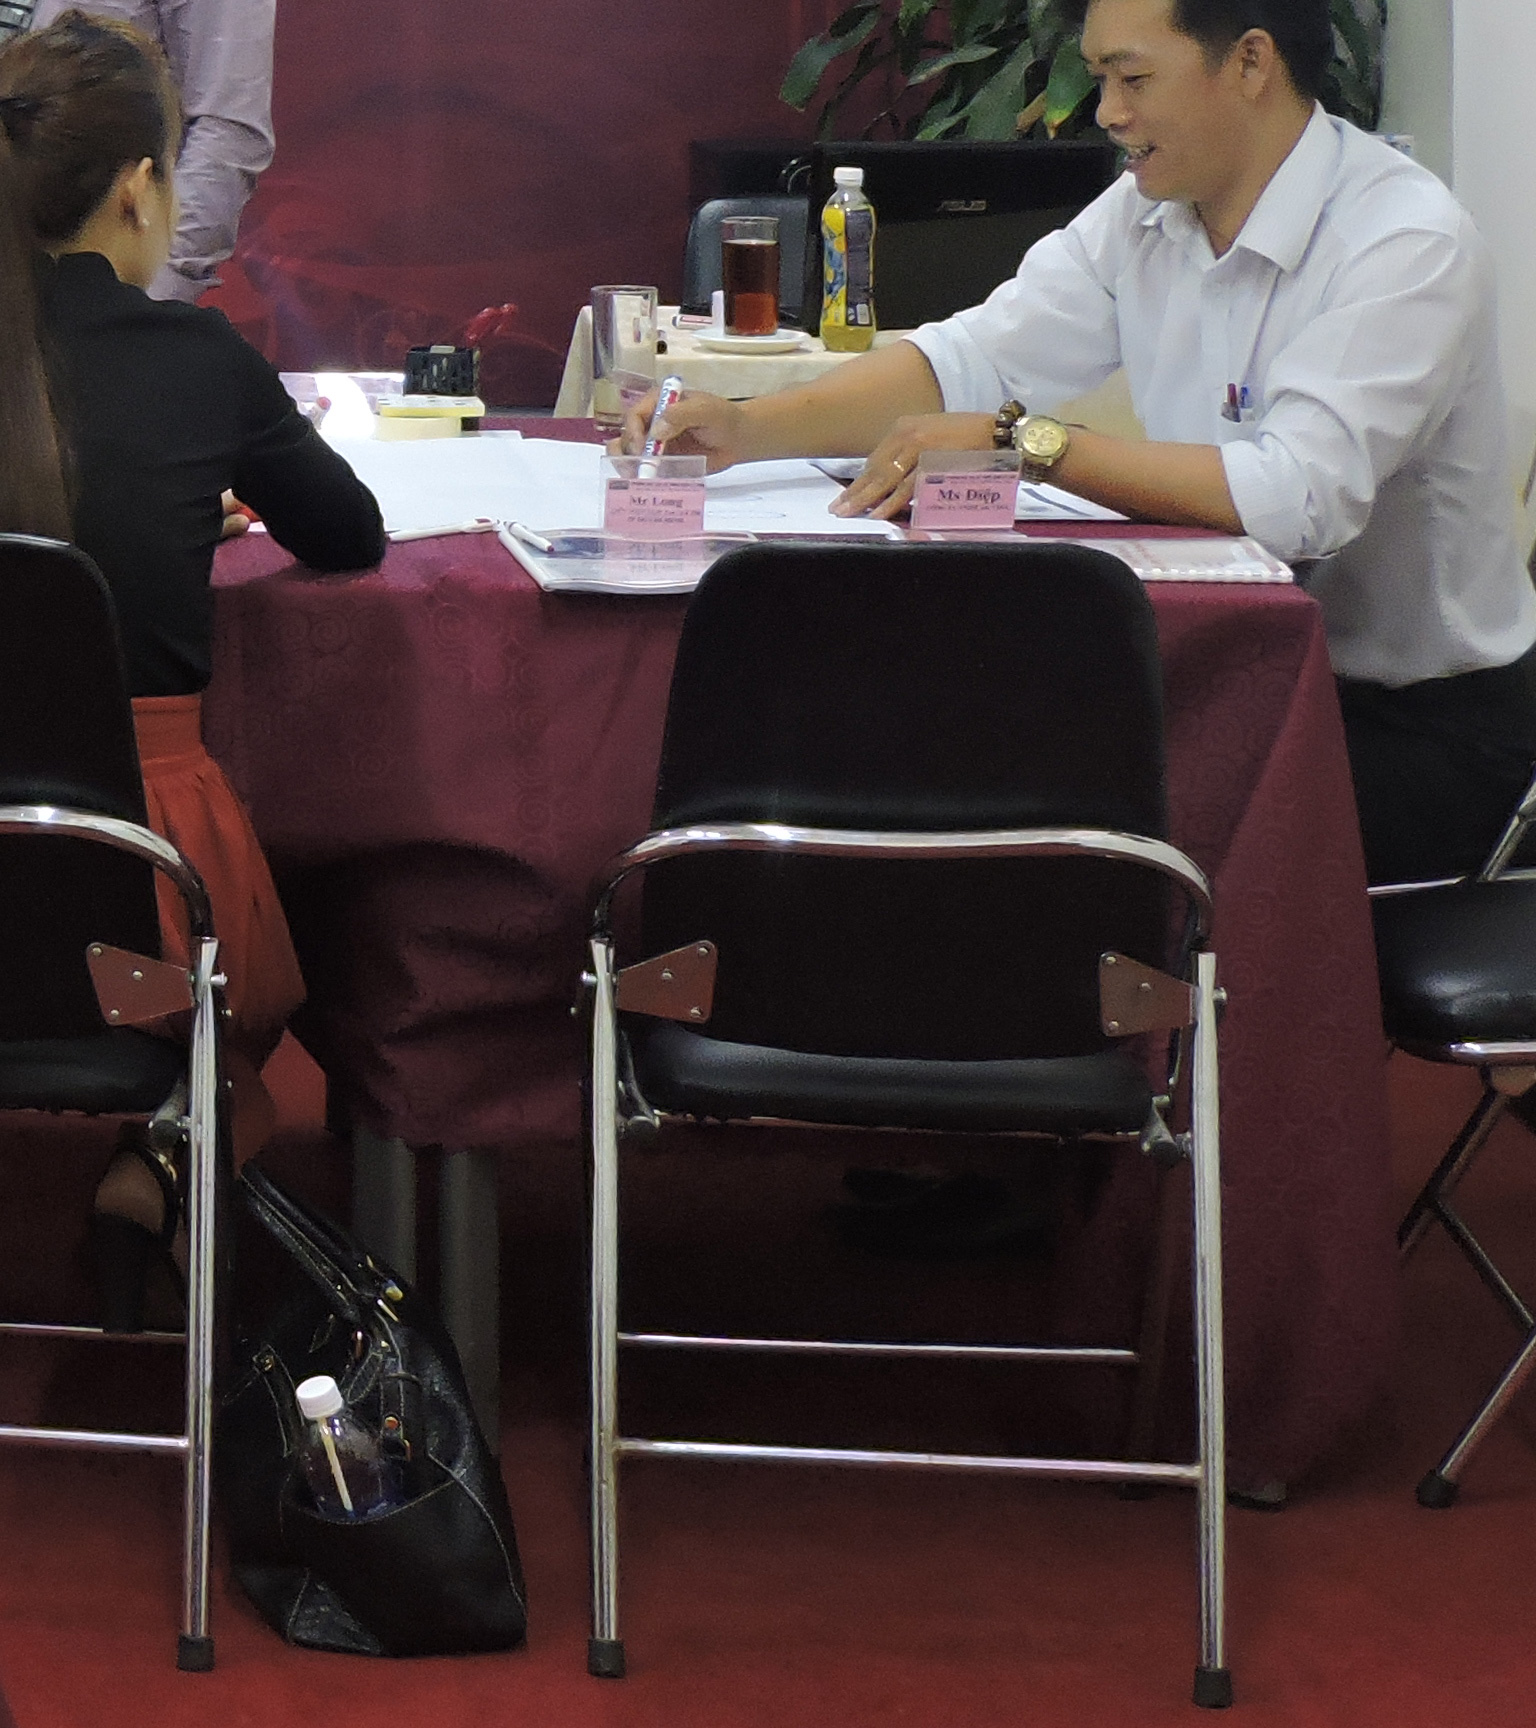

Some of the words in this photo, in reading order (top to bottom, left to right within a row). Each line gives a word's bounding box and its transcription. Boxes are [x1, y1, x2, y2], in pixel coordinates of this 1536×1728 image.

[938, 488, 960, 501] Ms
[630, 495, 648, 506] Mr
[652, 496, 684, 508] Long
